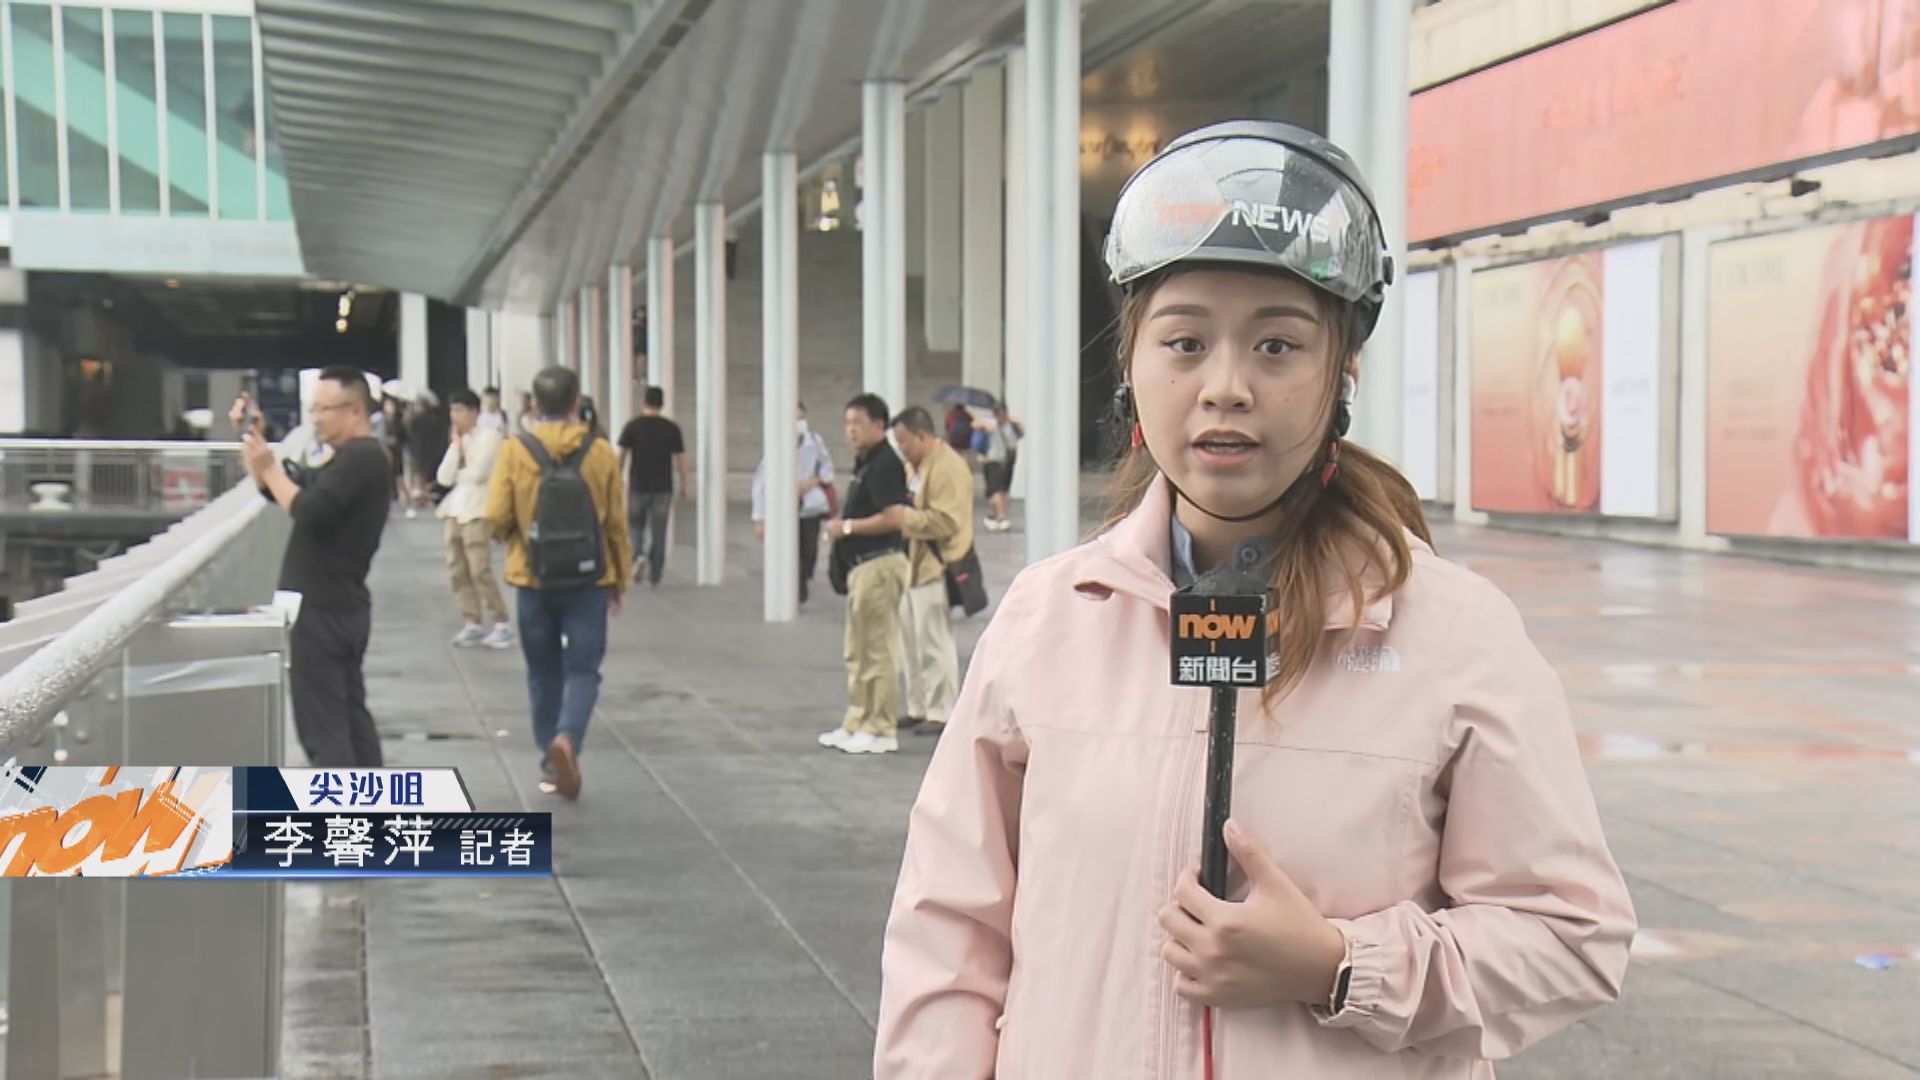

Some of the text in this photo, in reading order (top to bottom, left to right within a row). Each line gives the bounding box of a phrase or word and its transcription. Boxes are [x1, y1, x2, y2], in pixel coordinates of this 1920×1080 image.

[1232, 199, 1329, 243] NEWS
[1180, 614, 1256, 638] now
[1179, 656, 1256, 682] 新聞台
